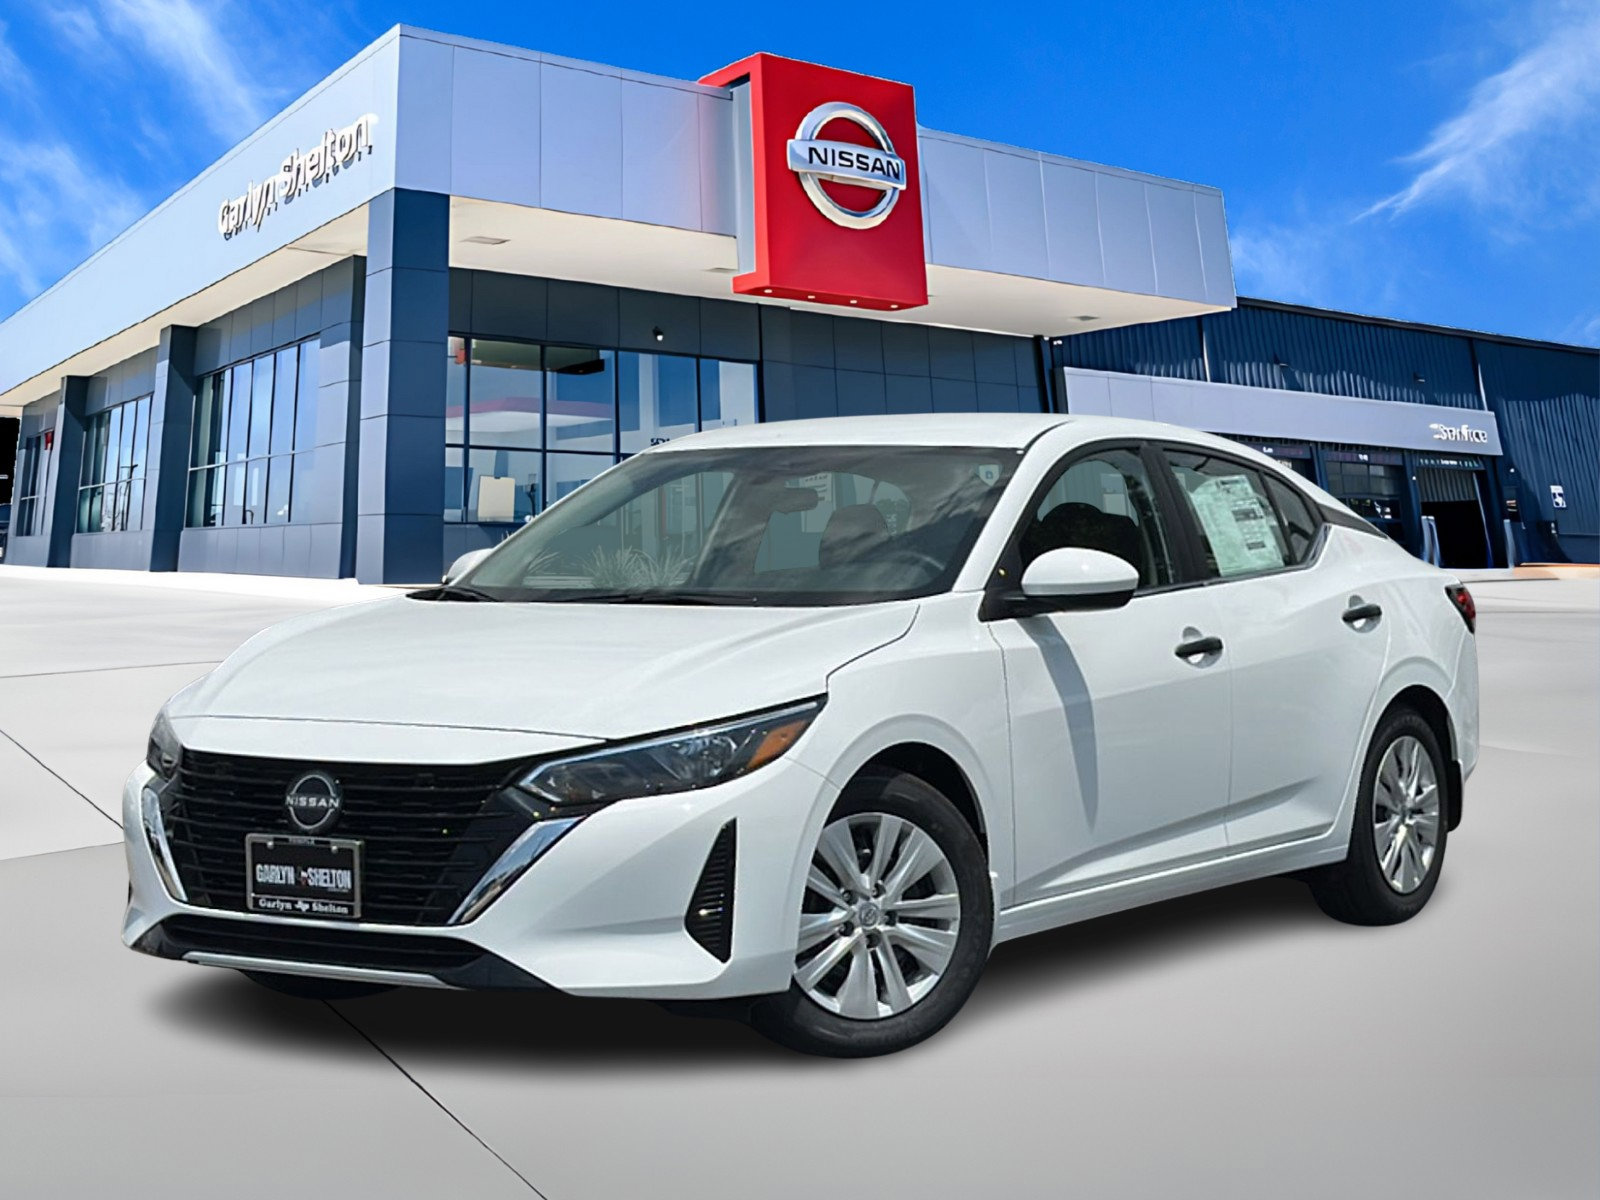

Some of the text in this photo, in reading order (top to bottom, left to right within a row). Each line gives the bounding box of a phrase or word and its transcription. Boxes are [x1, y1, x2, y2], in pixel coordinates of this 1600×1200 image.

[278, 117, 373, 204] Shelton
[808, 146, 901, 180] NISSAN
[285, 795, 340, 808] NISSAN
[255, 864, 352, 889] GARLYN SHELTON
[258, 898, 349, 914] Garlyn Shelton
